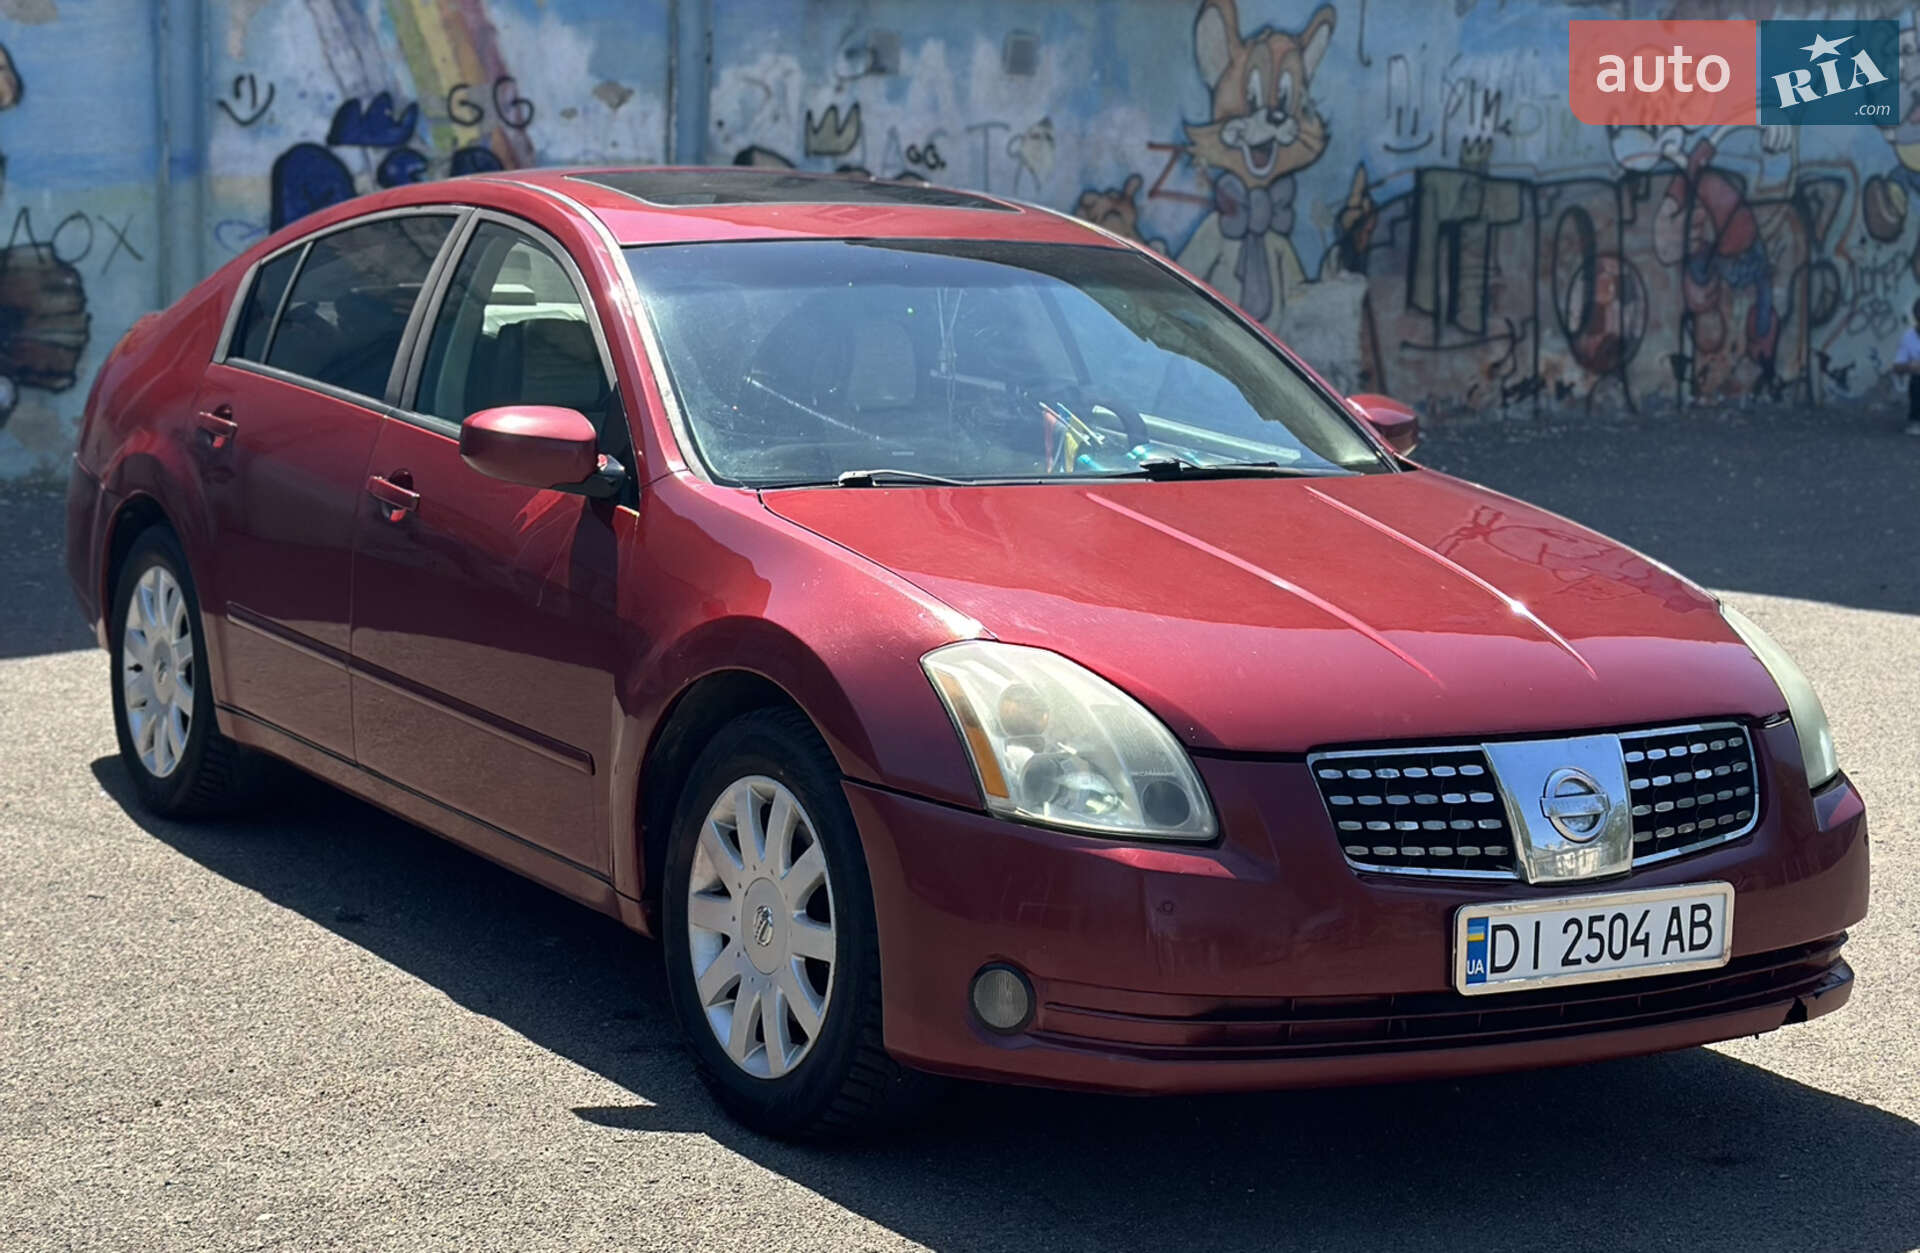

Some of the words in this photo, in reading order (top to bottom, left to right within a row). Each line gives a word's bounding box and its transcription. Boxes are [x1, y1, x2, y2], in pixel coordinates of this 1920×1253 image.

[1490, 920, 1541, 974] DI
[1561, 909, 1651, 968] 2504
[1662, 903, 1713, 955] AB
[1466, 959, 1485, 975] UA
